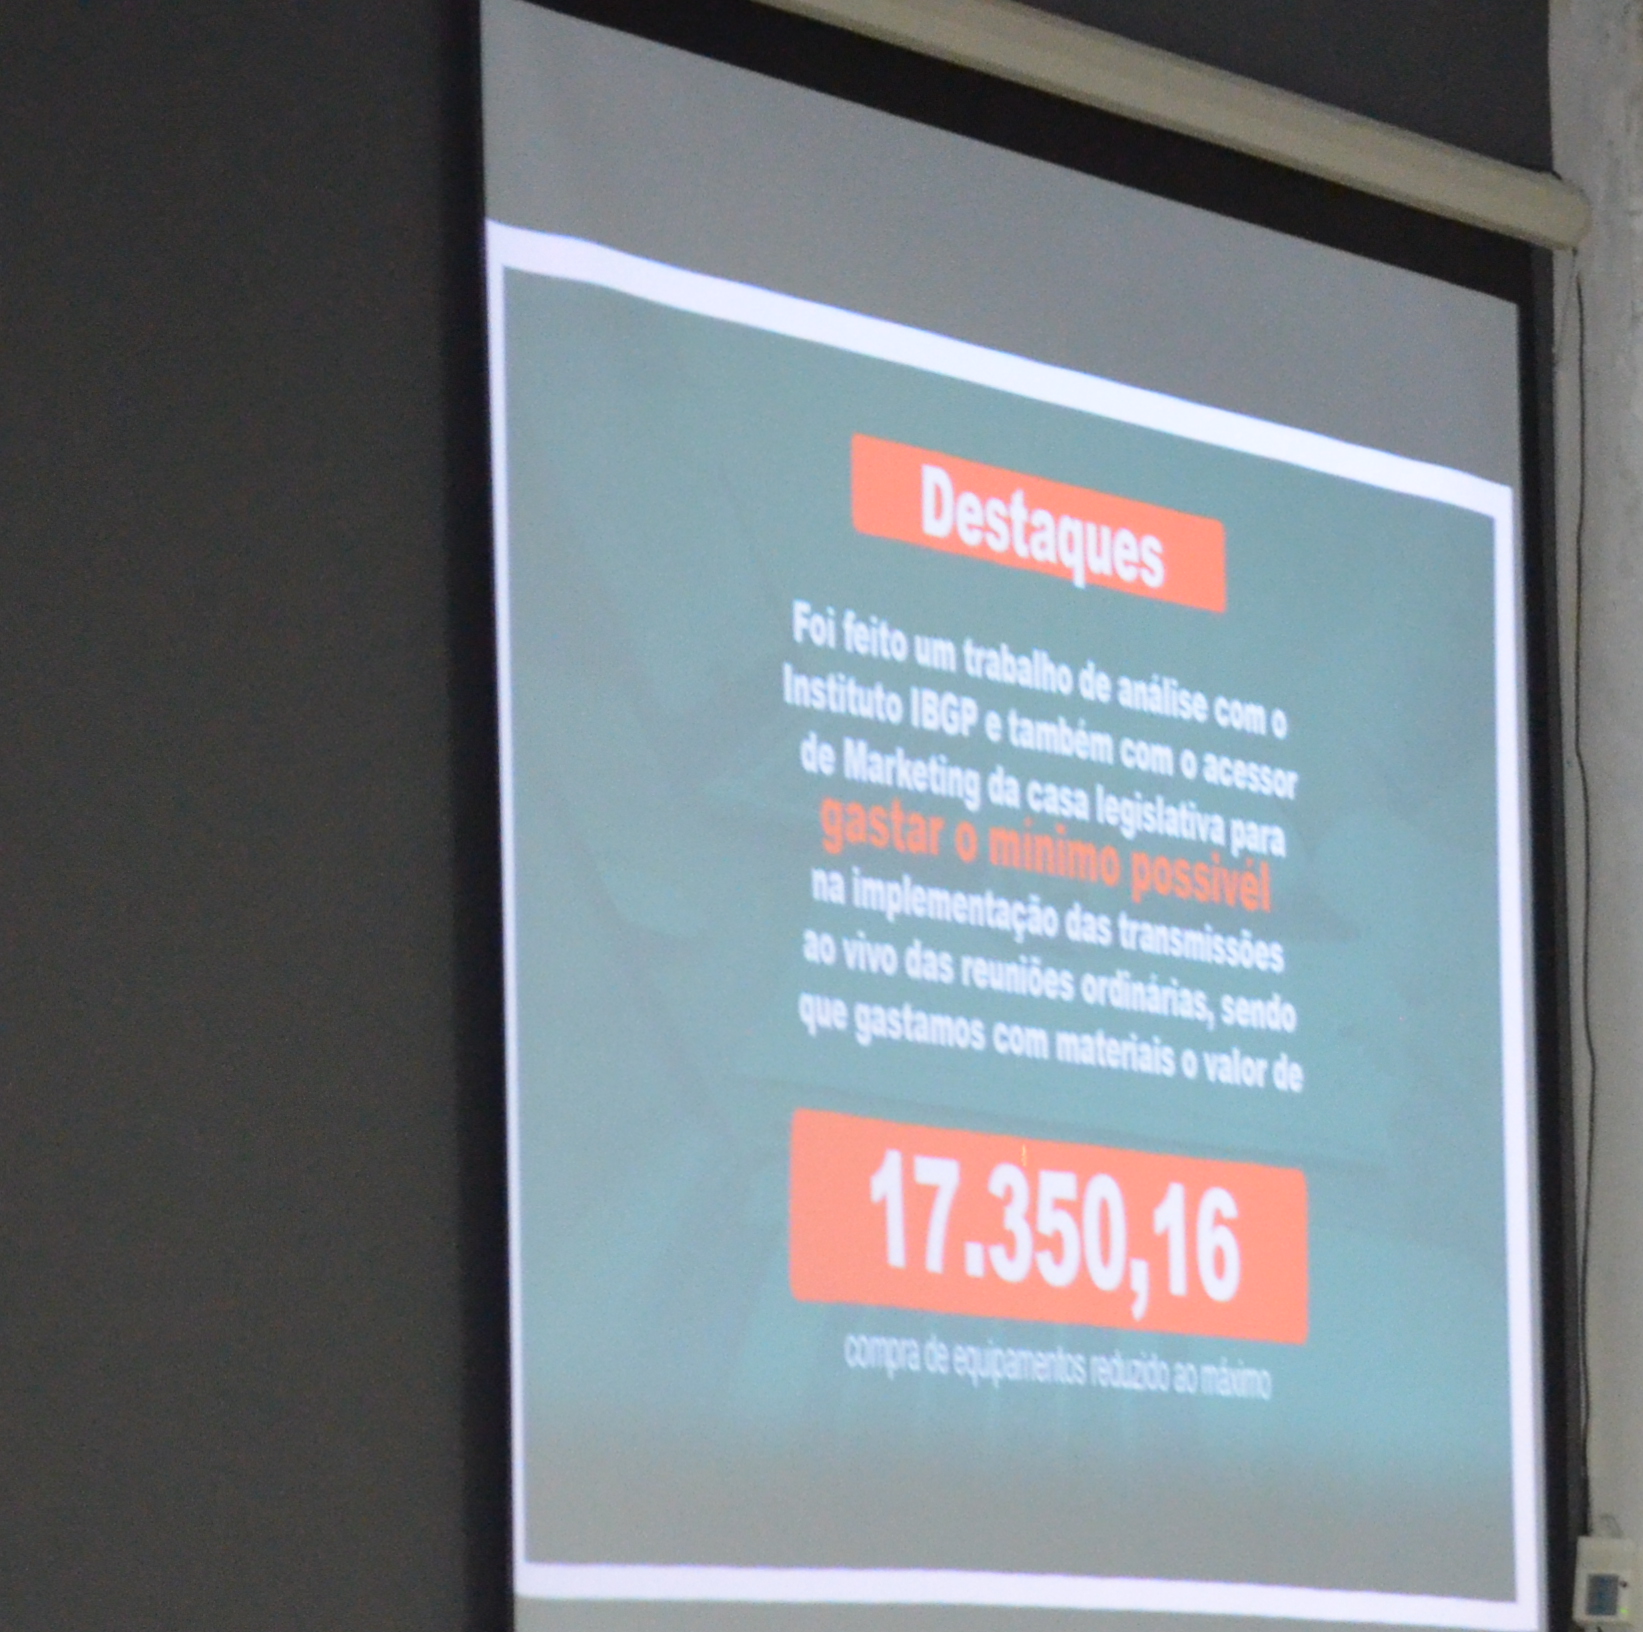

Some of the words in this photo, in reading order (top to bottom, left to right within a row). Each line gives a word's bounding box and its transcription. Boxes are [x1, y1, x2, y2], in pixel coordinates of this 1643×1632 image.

[921, 463, 1165, 589] Destaques
[792, 598, 836, 649] Foi
[843, 609, 909, 662] feito
[914, 634, 957, 673] um
[962, 636, 1073, 695] trabalho
[1078, 659, 1112, 703] de
[1117, 673, 1209, 723] análise
[1213, 695, 1267, 736] com
[1271, 707, 1288, 740] o
[783, 662, 903, 726] Instituto
[910, 685, 978, 737] IBGP
[985, 709, 1003, 742] e
[1008, 707, 1114, 765] também
[1119, 737, 1174, 777] com
[1179, 748, 1198, 780] o
[1203, 751, 1299, 800] acessor
[800, 730, 836, 776] de
[843, 736, 981, 813] Marketing
[987, 764, 1020, 808] da
[1026, 778, 1089, 822] casa
[1095, 783, 1226, 841] legislativa
[1230, 818, 1287, 858] para
[820, 796, 945, 856] gastar
[955, 820, 978, 864] o
[811, 866, 846, 905] na
[852, 865, 1059, 944] implementação
[1064, 899, 1112, 946] das
[1118, 909, 1285, 974] transmissões
[803, 928, 836, 966] ao
[842, 929, 898, 976] vivo
[904, 938, 955, 984] das
[961, 954, 1075, 1002] reuniões
[1081, 968, 1215, 1031] ordinárias,
[1220, 992, 1298, 1034] sendo
[798, 991, 849, 1037] que
[854, 1002, 986, 1047] gastamos
[993, 1021, 1050, 1060] com
[1055, 1028, 1176, 1078] materiais
[1181, 1048, 1198, 1079] o
[1203, 1046, 1268, 1088] valor
[1272, 1052, 1305, 1093] de
[870, 1148, 1242, 1321] 17.350,16
[844, 1333, 920, 1379] compra
[924, 1335, 949, 1374] de
[953, 1338, 1086, 1388] equipamentos
[1089, 1350, 1170, 1392] reduzido
[1174, 1361, 1197, 1394] ao
[1201, 1356, 1272, 1400] máximo
